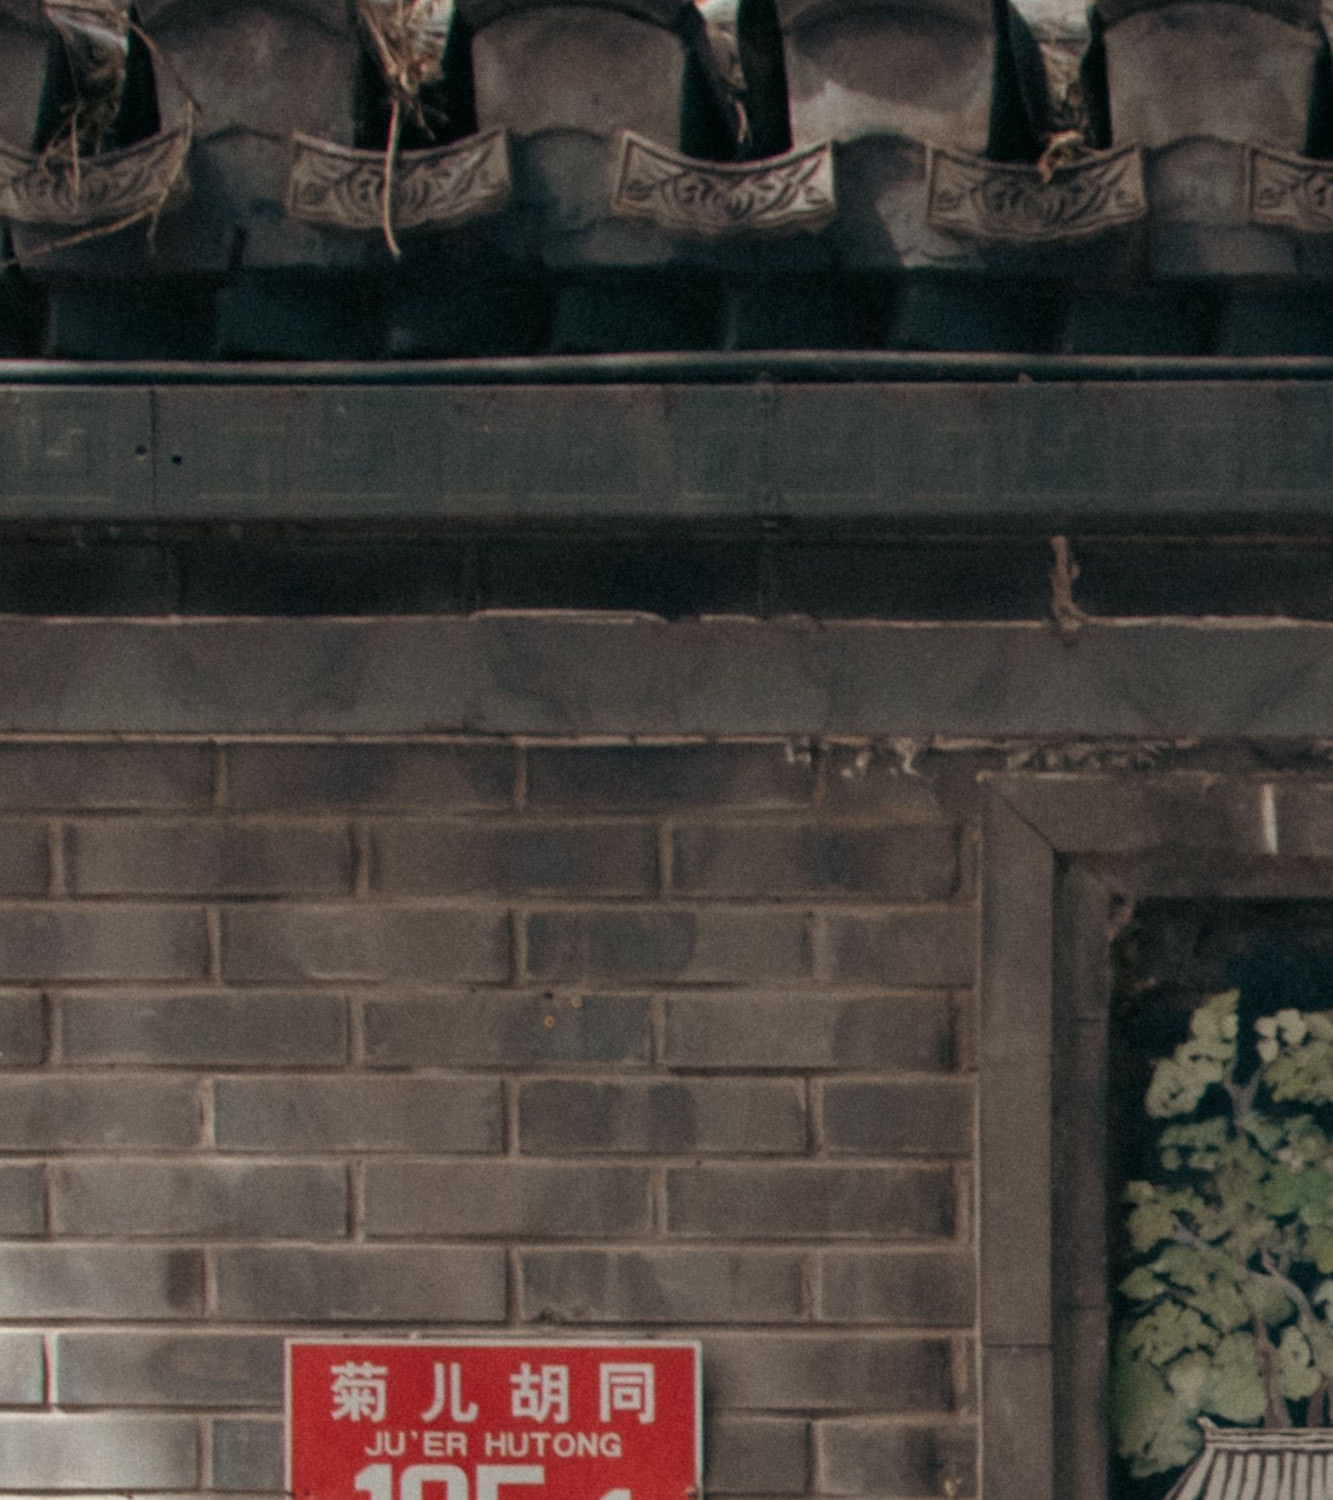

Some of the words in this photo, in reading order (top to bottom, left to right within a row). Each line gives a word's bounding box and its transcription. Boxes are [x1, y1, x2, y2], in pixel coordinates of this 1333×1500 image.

[330, 1361, 656, 1424] 菊儿胡同
[364, 1430, 468, 1457] JU'ER
[484, 1431, 623, 1459] HUTONG
